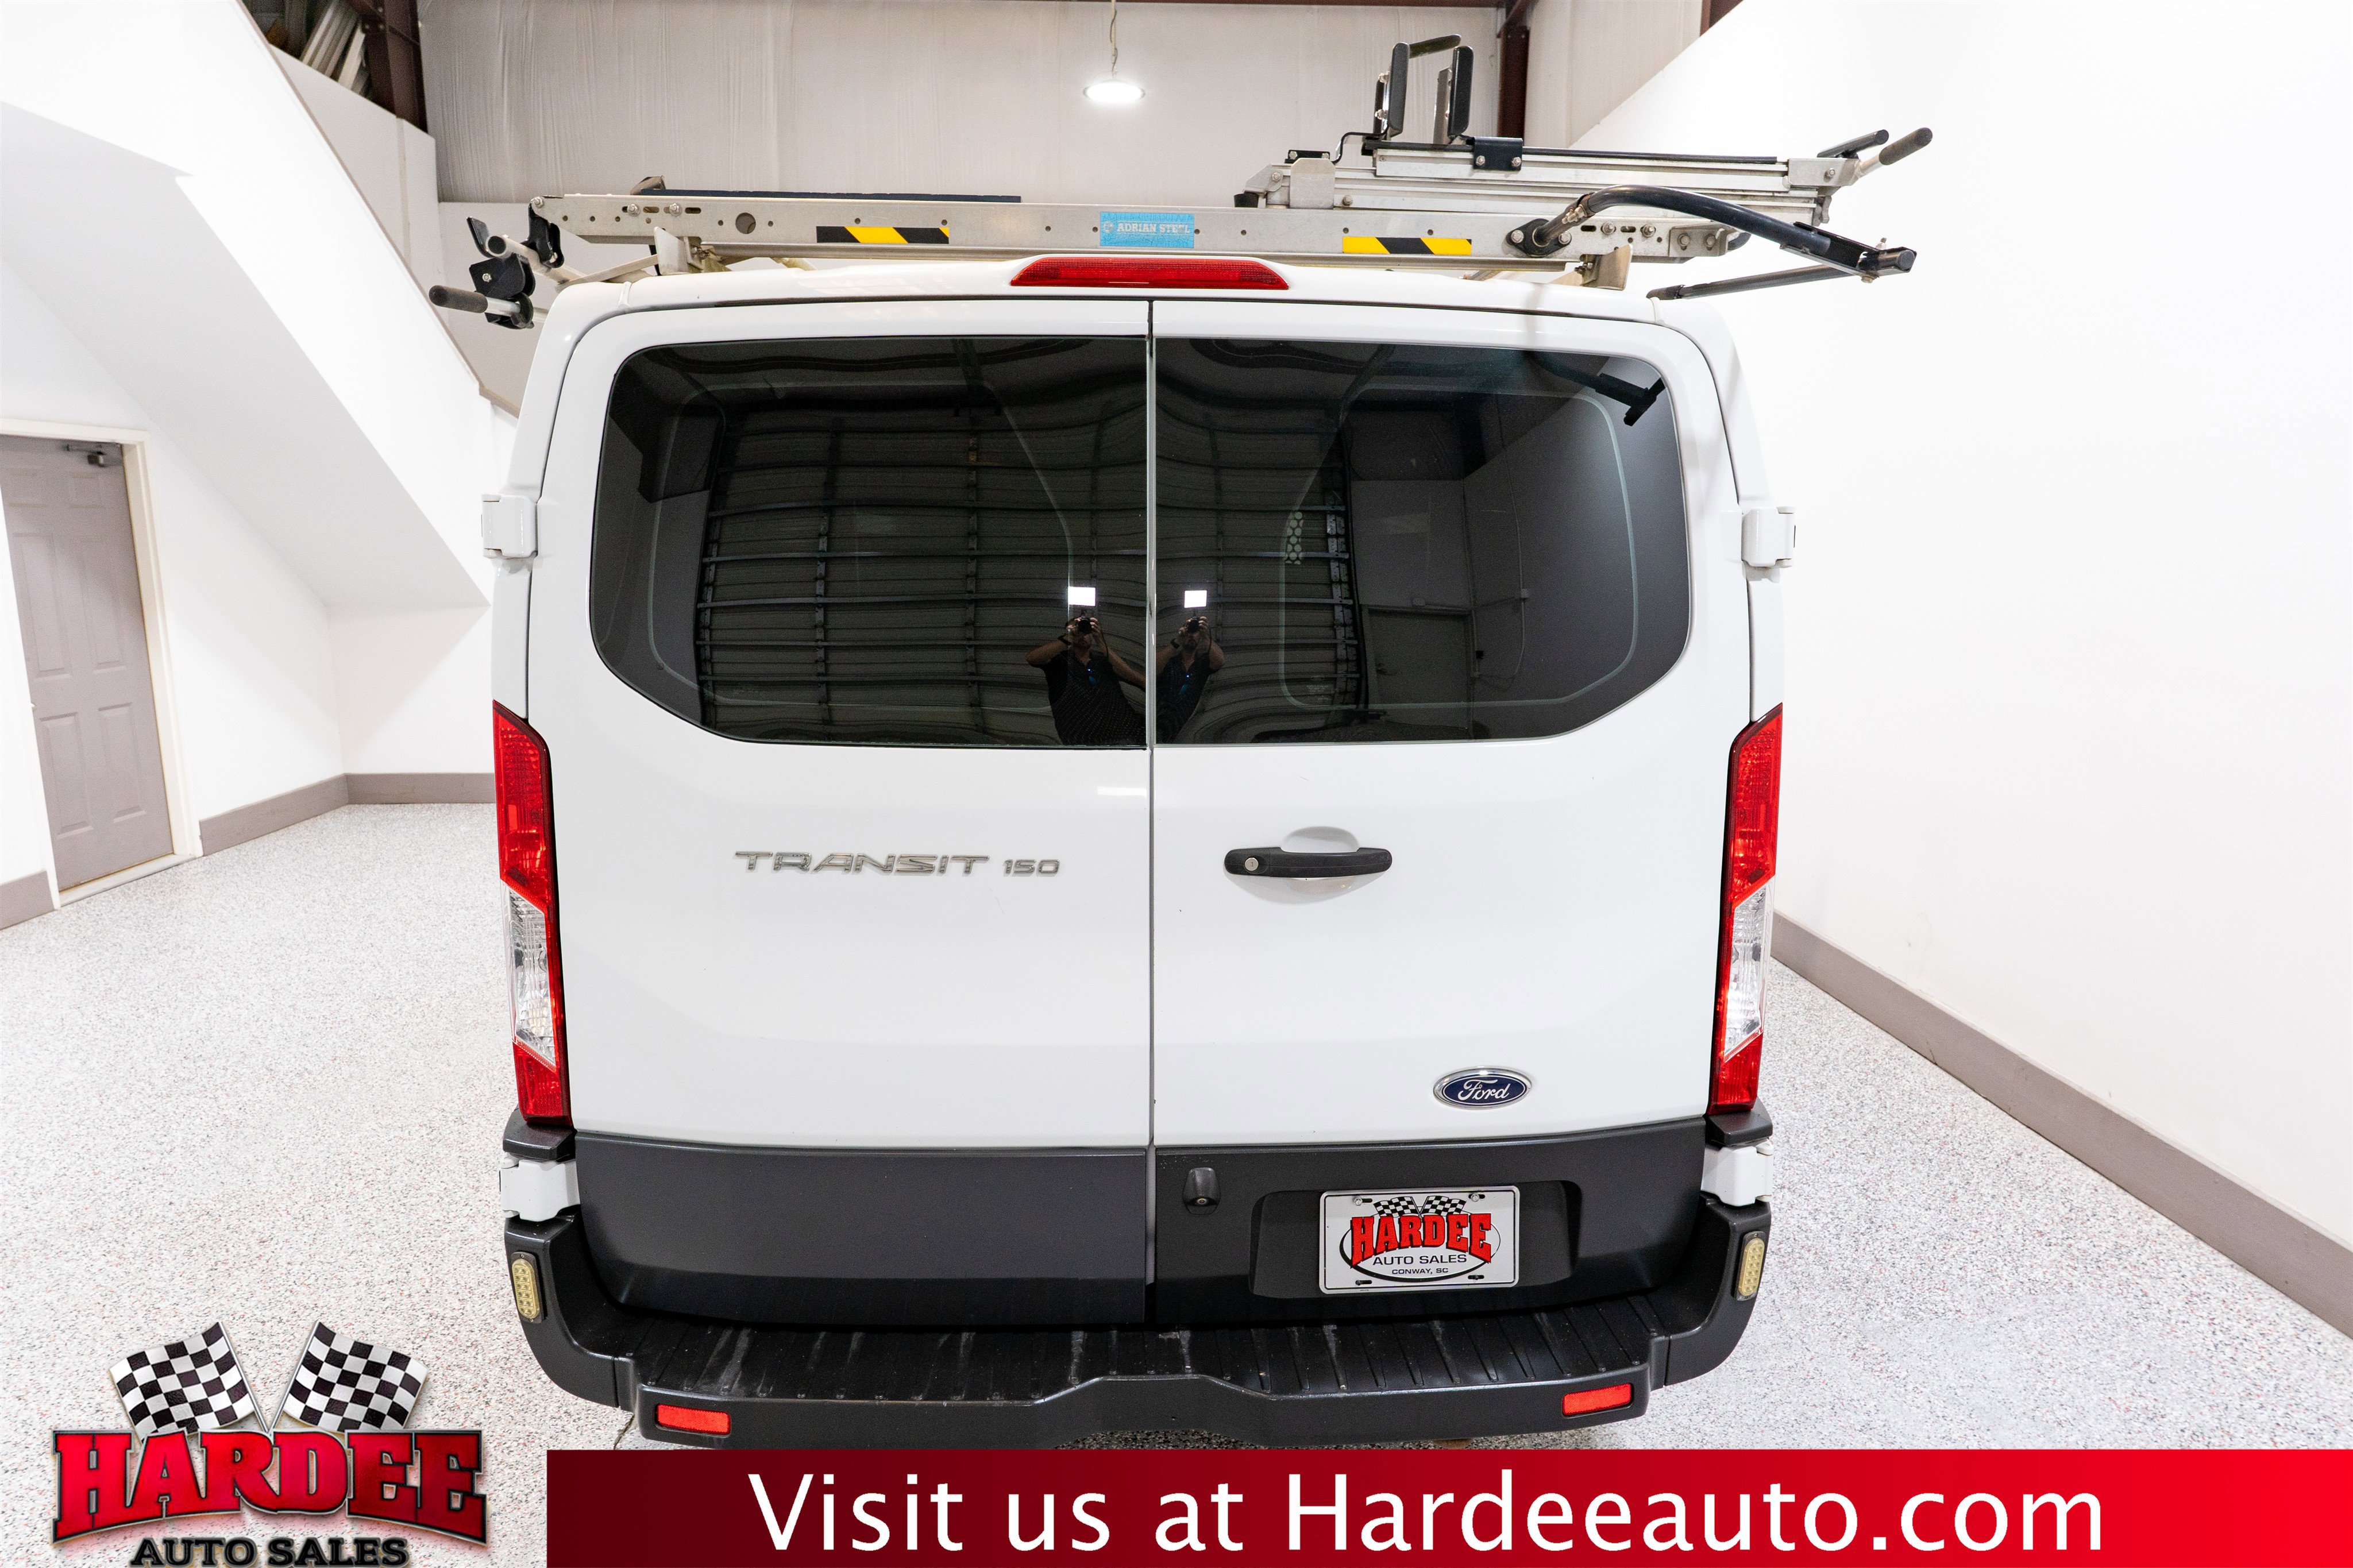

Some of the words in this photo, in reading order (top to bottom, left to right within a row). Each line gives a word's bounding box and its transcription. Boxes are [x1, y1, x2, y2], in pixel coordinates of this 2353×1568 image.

[1117, 223, 1156, 232] ADRIAN
[735, 851, 990, 874] TRANSIT
[1004, 859, 1060, 876] 150
[1457, 1079, 1511, 1100] Ford
[1350, 1213, 1492, 1267] HARDEE
[1372, 1256, 1414, 1266] AUTO
[1419, 1254, 1467, 1264] SALES
